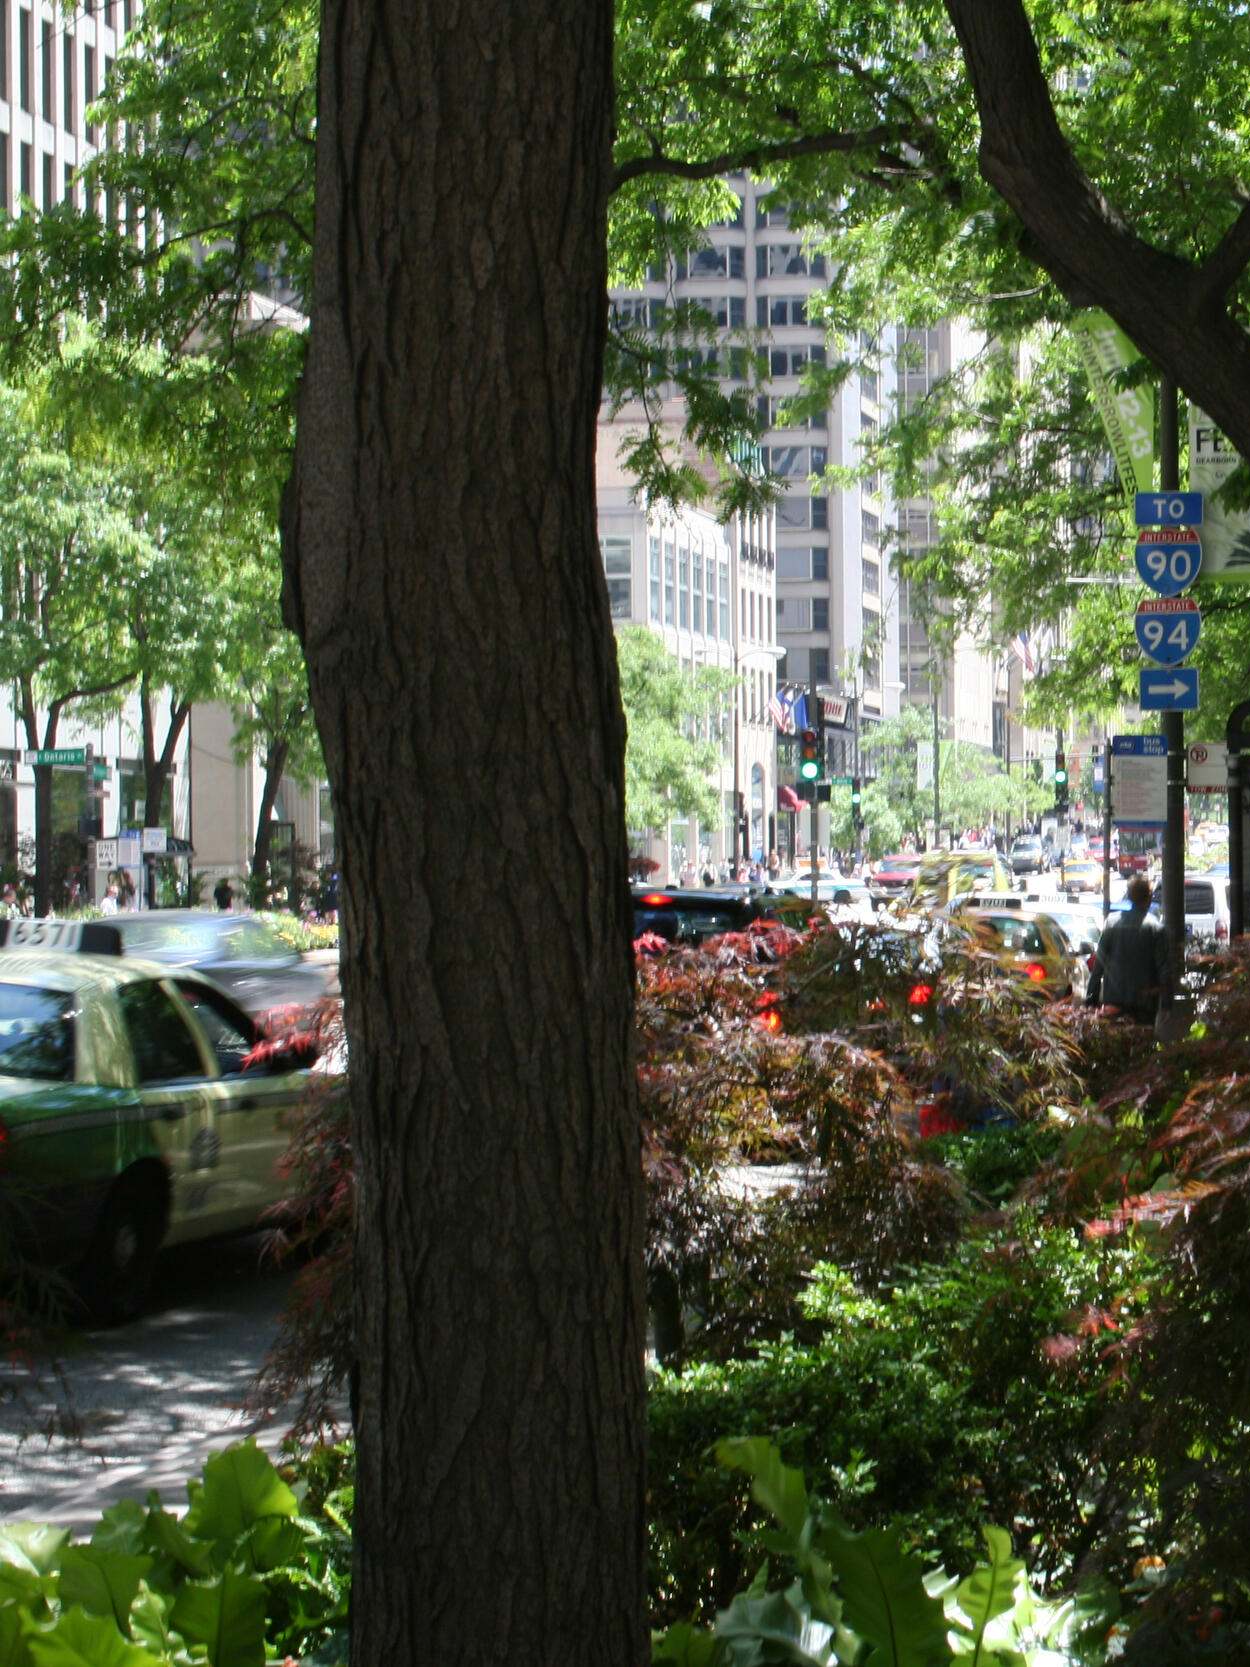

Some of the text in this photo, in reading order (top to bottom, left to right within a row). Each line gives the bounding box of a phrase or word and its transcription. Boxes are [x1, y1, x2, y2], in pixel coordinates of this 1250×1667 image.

[1153, 500, 1185, 519] TO
[1144, 531, 1192, 542] INTERSTATE
[1146, 551, 1191, 582] 90
[1144, 602, 1190, 613] INTERSTATE
[1143, 620, 1189, 651] 94
[1143, 744, 1164, 755] stop
[44, 751, 75, 762] Ontario
